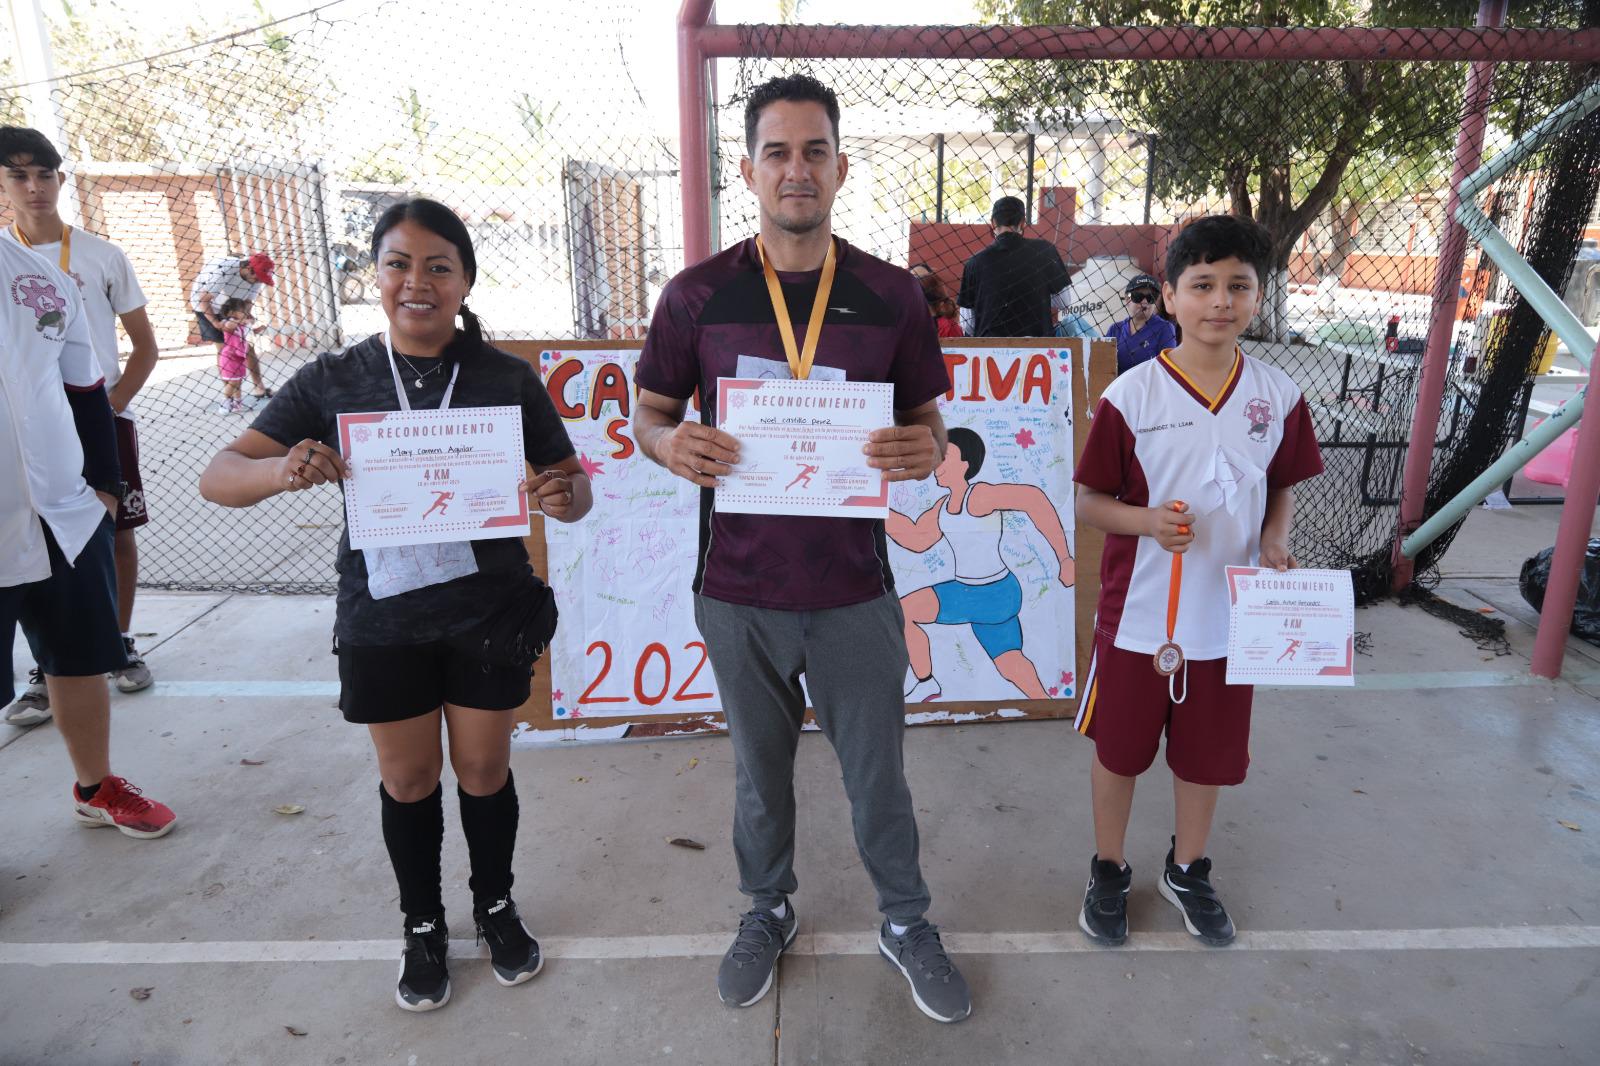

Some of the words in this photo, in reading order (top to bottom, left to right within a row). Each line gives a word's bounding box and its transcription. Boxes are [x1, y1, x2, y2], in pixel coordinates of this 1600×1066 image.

[753, 395, 867, 410] RECONOCIMIENTO
[1178, 420, 1194, 428] LIAM
[377, 423, 494, 439] RECONOCIMIENTO
[791, 441, 798, 452] 4
[800, 441, 817, 453] KM
[424, 470, 431, 481] 4
[434, 469, 450, 481] KM
[1255, 580, 1335, 592] RECONOCIMIENTO
[1290, 619, 1303, 629] KM
[577, 640, 714, 706] 202
[488, 902, 506, 915] PUMA
[412, 926, 432, 934] PUMA
